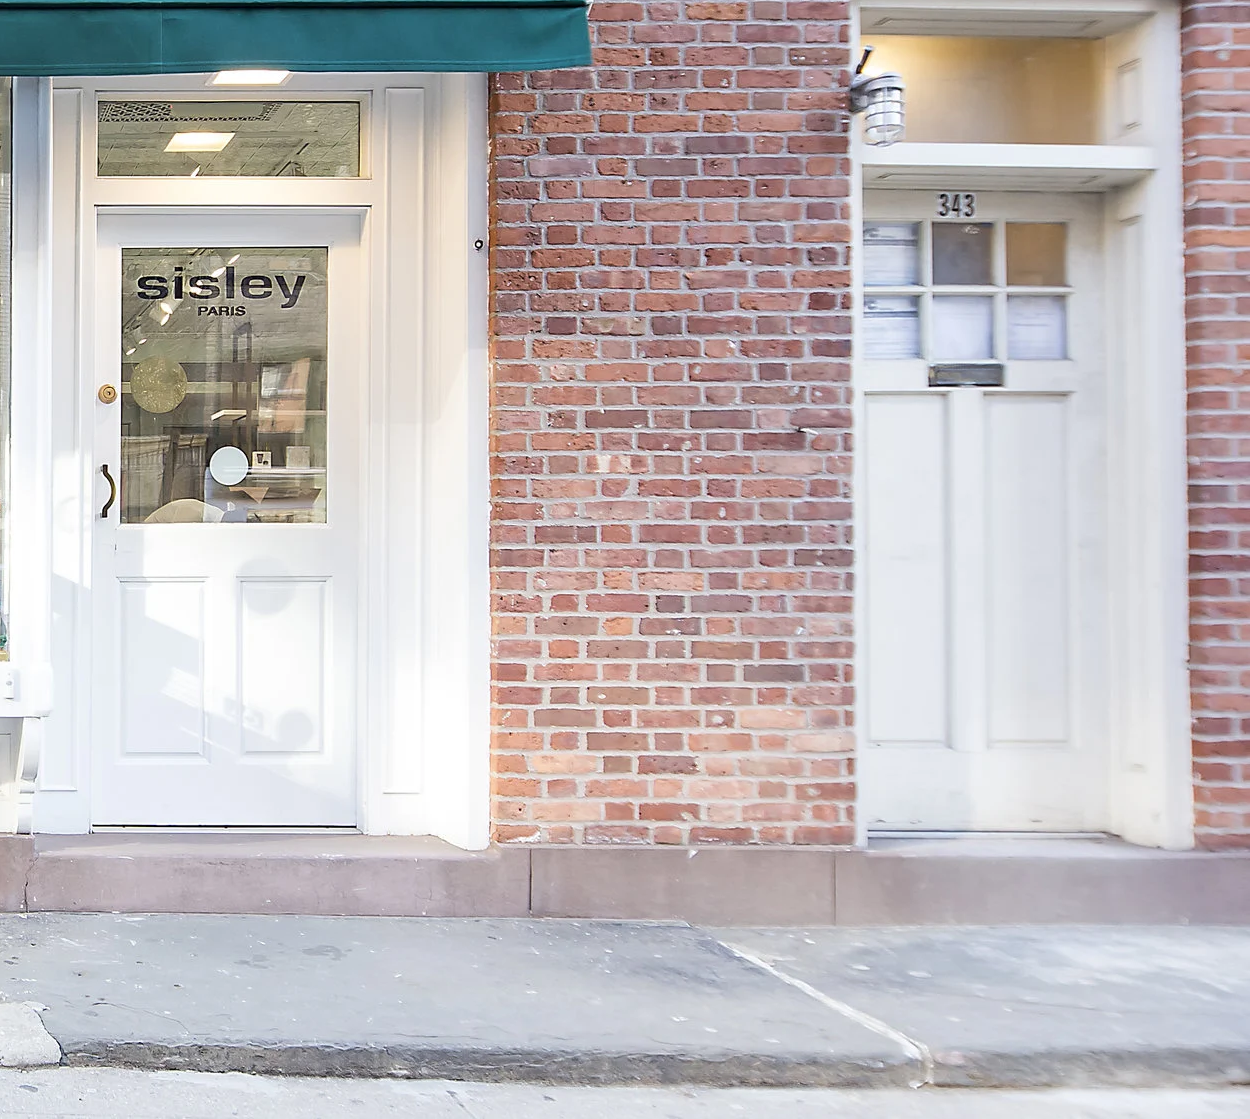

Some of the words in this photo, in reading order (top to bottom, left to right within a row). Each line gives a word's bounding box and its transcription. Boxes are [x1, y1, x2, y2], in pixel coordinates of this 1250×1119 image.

[939, 193, 976, 218] 343
[137, 265, 306, 309] sisley
[197, 305, 247, 317] PARIS
